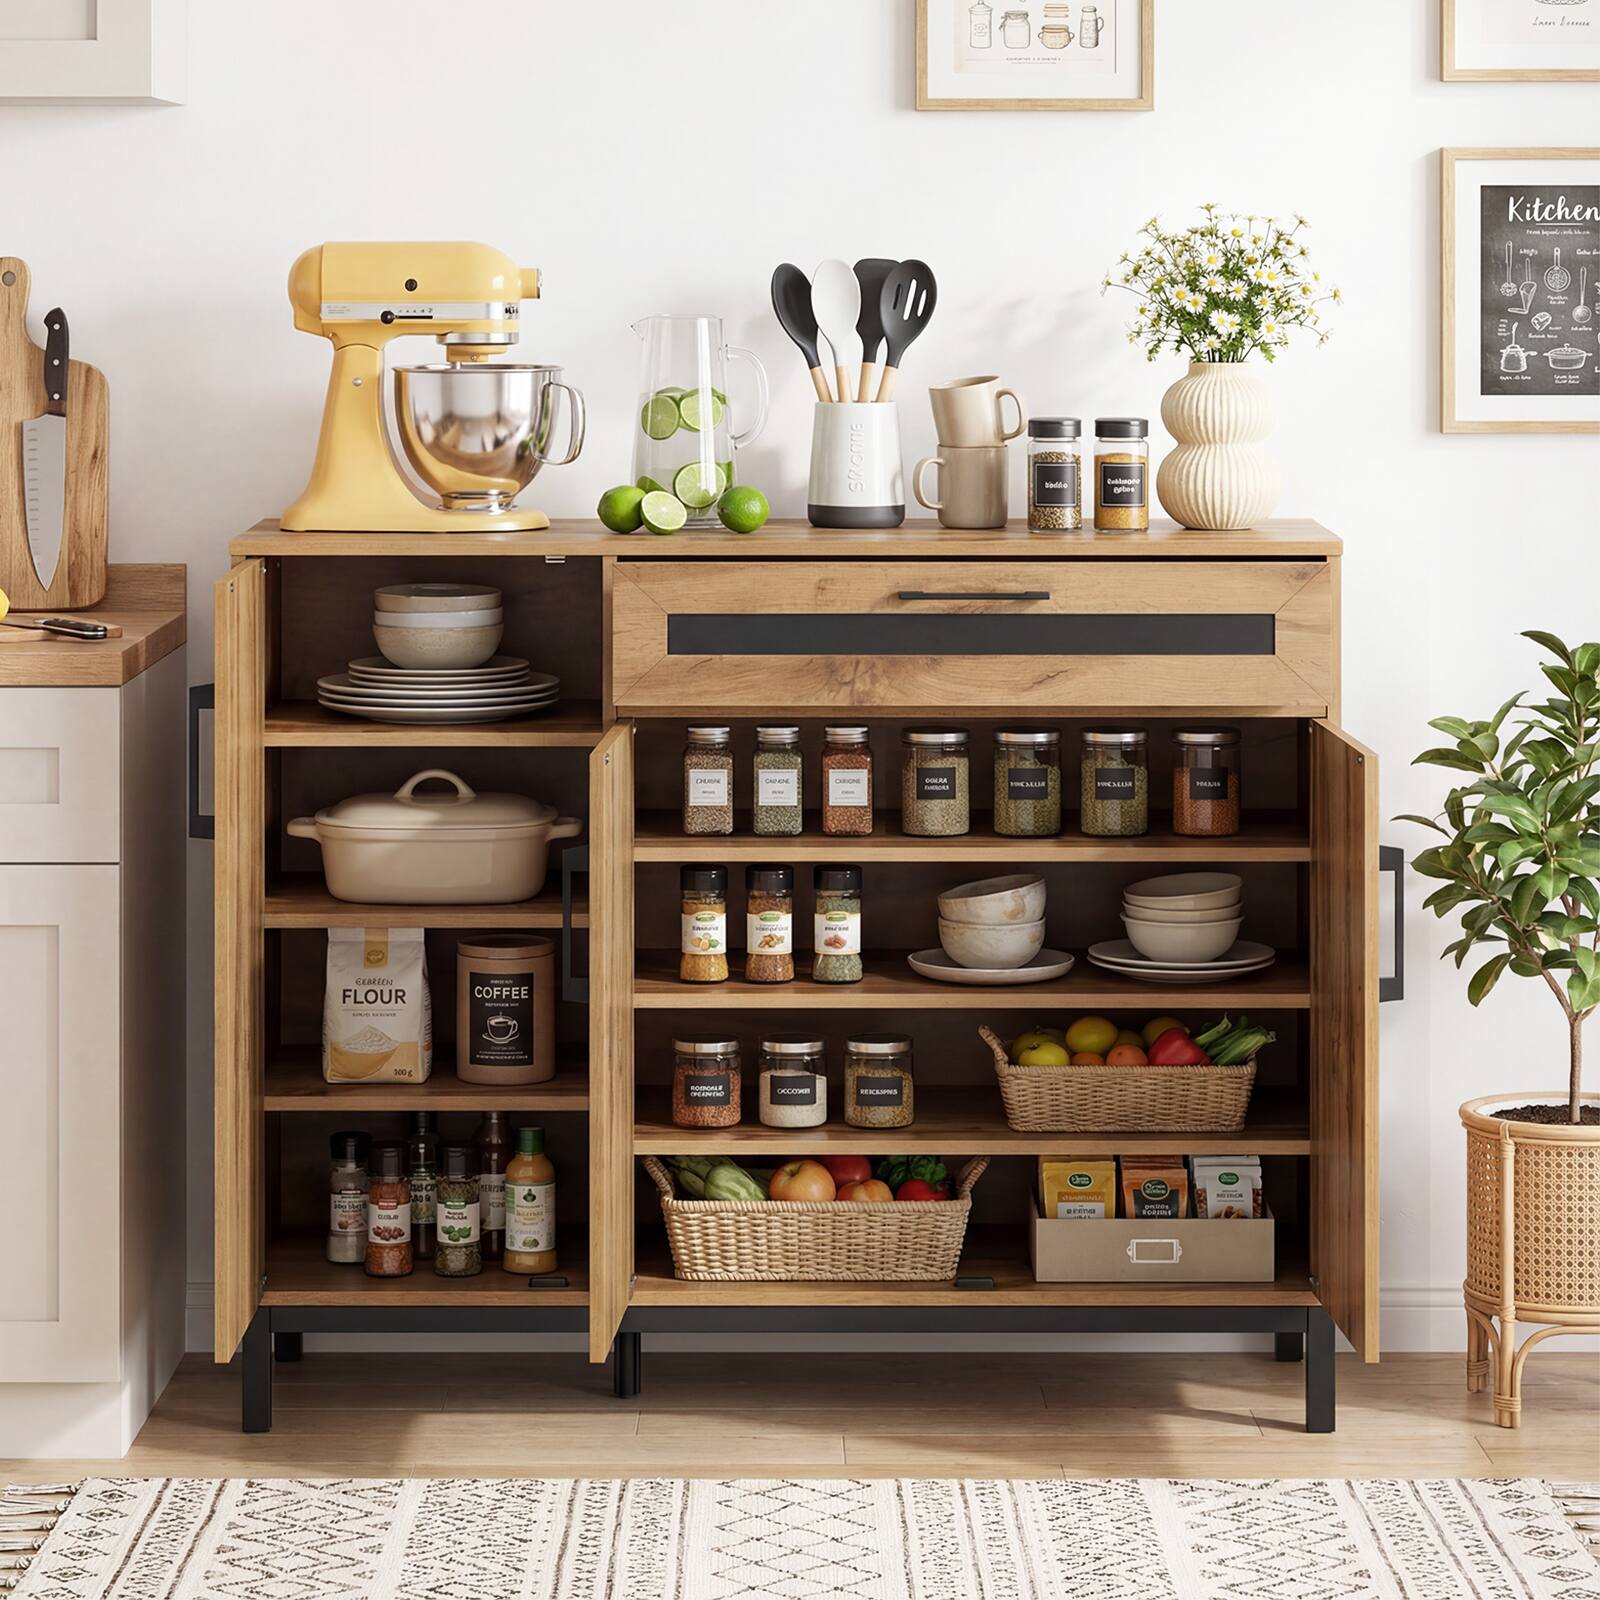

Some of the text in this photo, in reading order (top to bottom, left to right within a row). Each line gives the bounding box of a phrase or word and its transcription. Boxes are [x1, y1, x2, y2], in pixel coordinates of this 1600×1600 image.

[1508, 195, 1600, 222] Kitchen
[342, 988, 407, 1005] FLOUR
[474, 986, 529, 999] COFFEE
